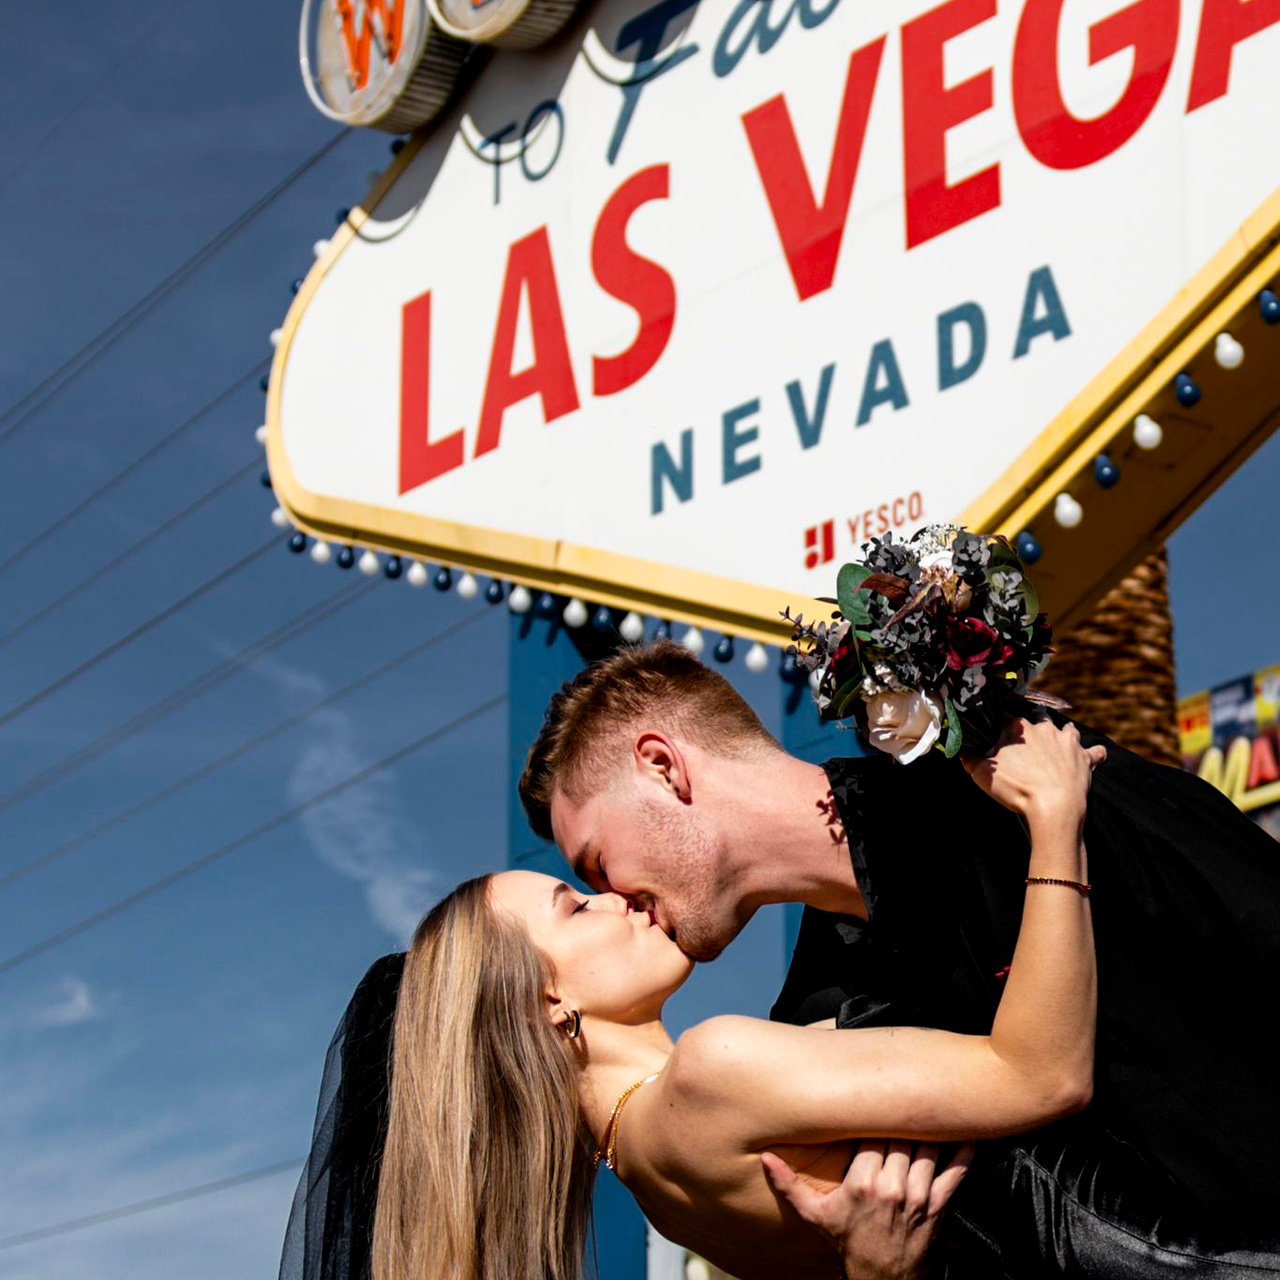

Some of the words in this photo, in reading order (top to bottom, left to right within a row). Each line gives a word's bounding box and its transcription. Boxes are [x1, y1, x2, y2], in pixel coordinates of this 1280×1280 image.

[477, 99, 565, 207] TO
[398, 162, 678, 496] LAS
[649, 264, 1074, 516] NEVADA
[847, 490, 924, 544] YESCO
